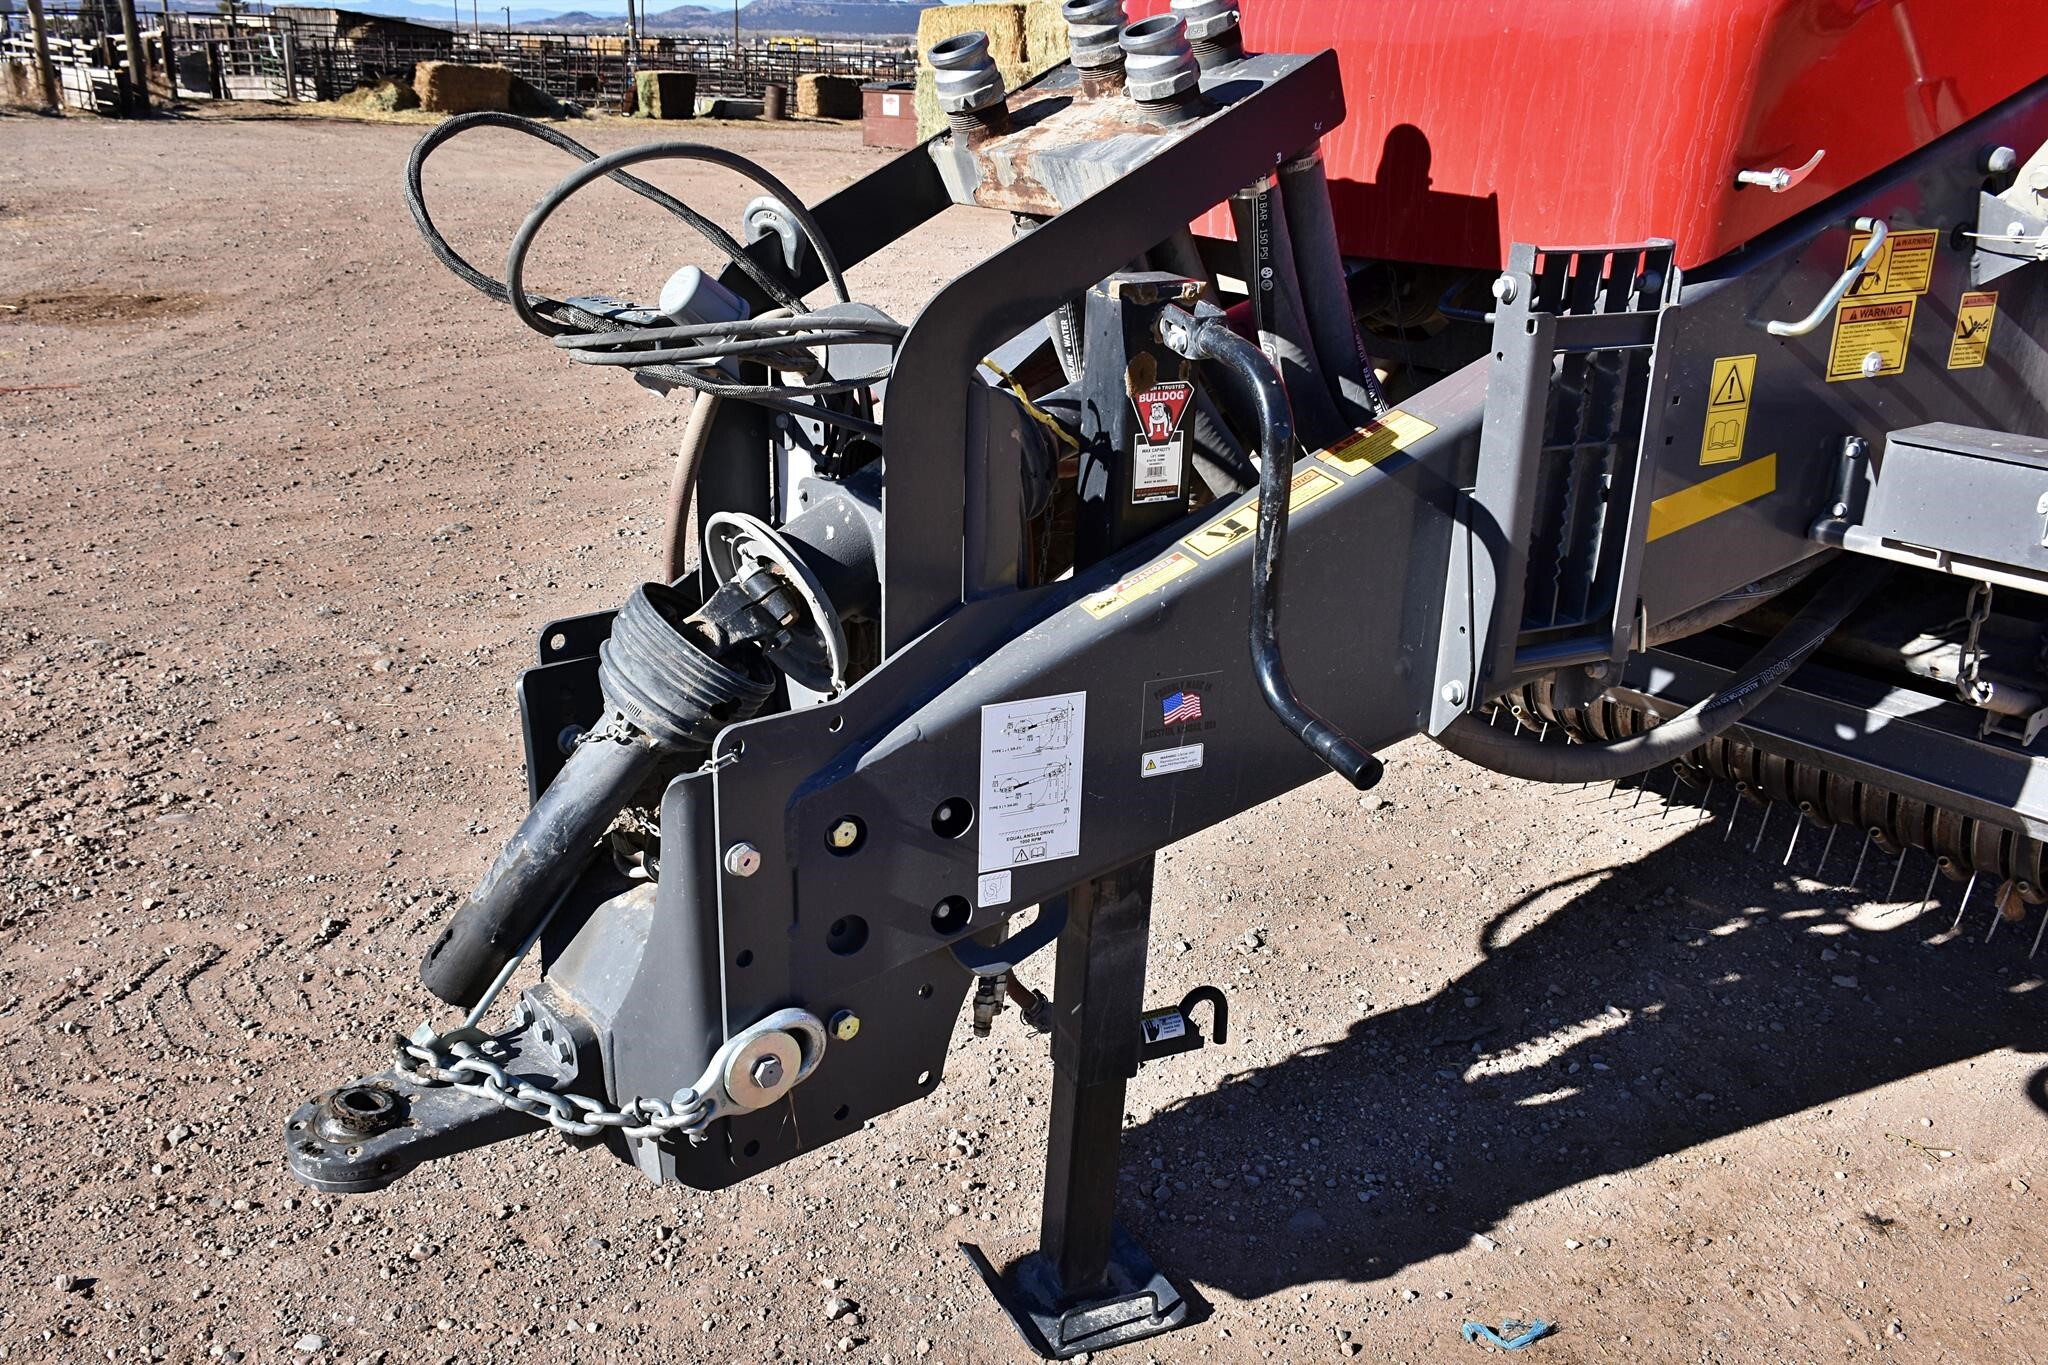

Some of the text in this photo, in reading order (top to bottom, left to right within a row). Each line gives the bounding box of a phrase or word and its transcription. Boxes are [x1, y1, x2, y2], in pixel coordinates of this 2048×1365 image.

[1259, 203, 1268, 220] BAR
[1259, 230, 1268, 245] 150
[1260, 246, 1269, 260] PSI
[1860, 306, 1903, 318] WARNING
[1061, 320, 1071, 347] WATER
[1363, 368, 1376, 398] WATER
[1139, 391, 1184, 403] BULLDOG
